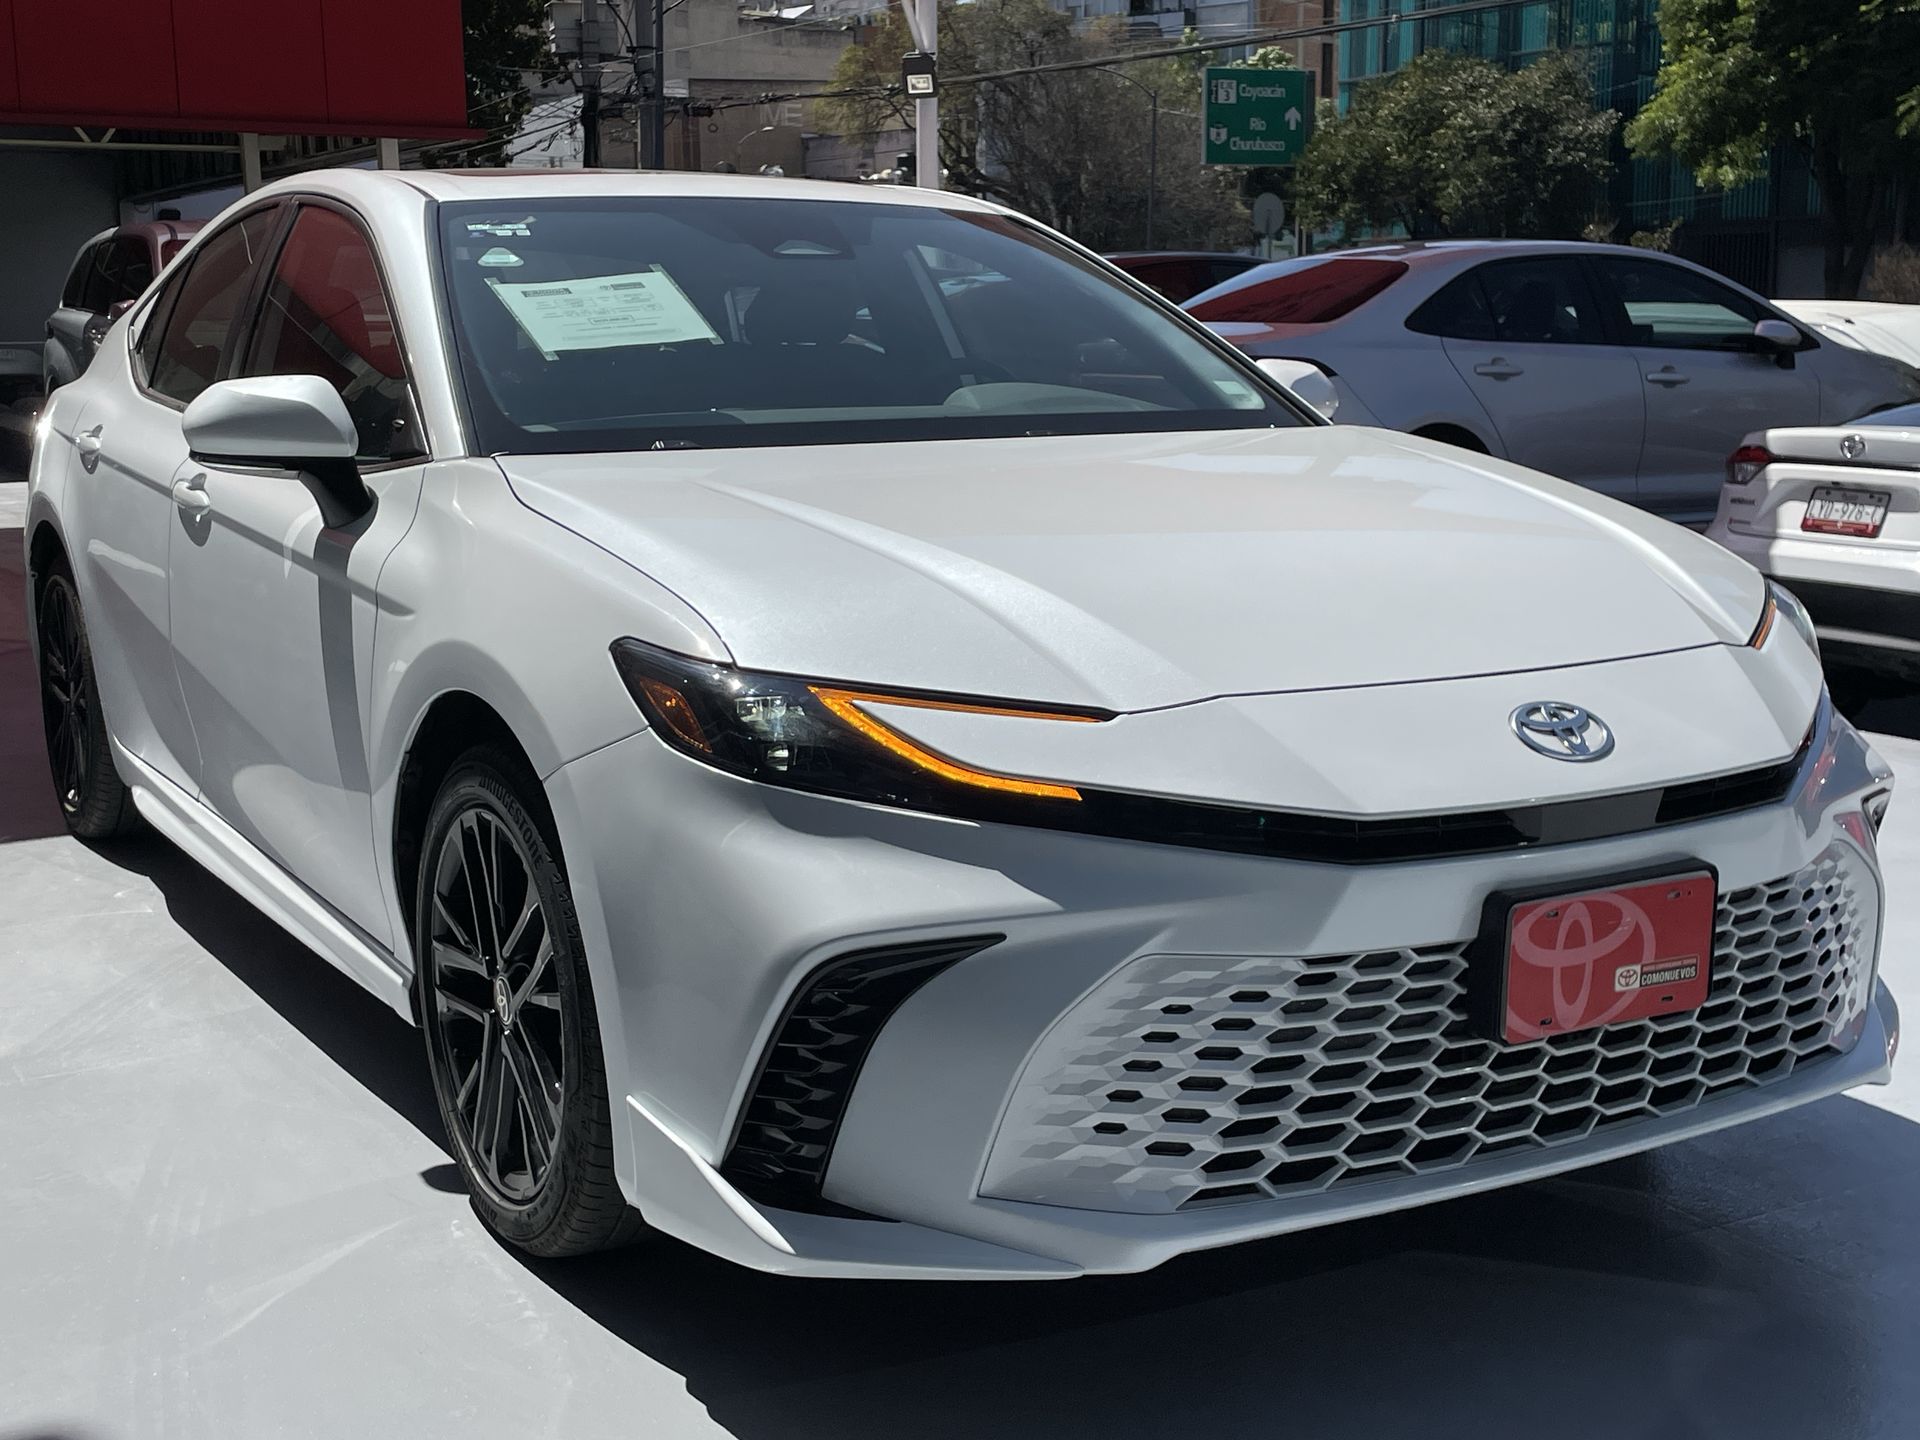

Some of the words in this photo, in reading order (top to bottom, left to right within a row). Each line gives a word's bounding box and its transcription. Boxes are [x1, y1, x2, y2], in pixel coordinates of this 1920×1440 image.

[1223, 89, 1232, 102] 3
[1239, 83, 1286, 101] Coyoacán
[1229, 136, 1286, 151] Churubusco
[1641, 965, 1696, 986] COMONUEVOS
